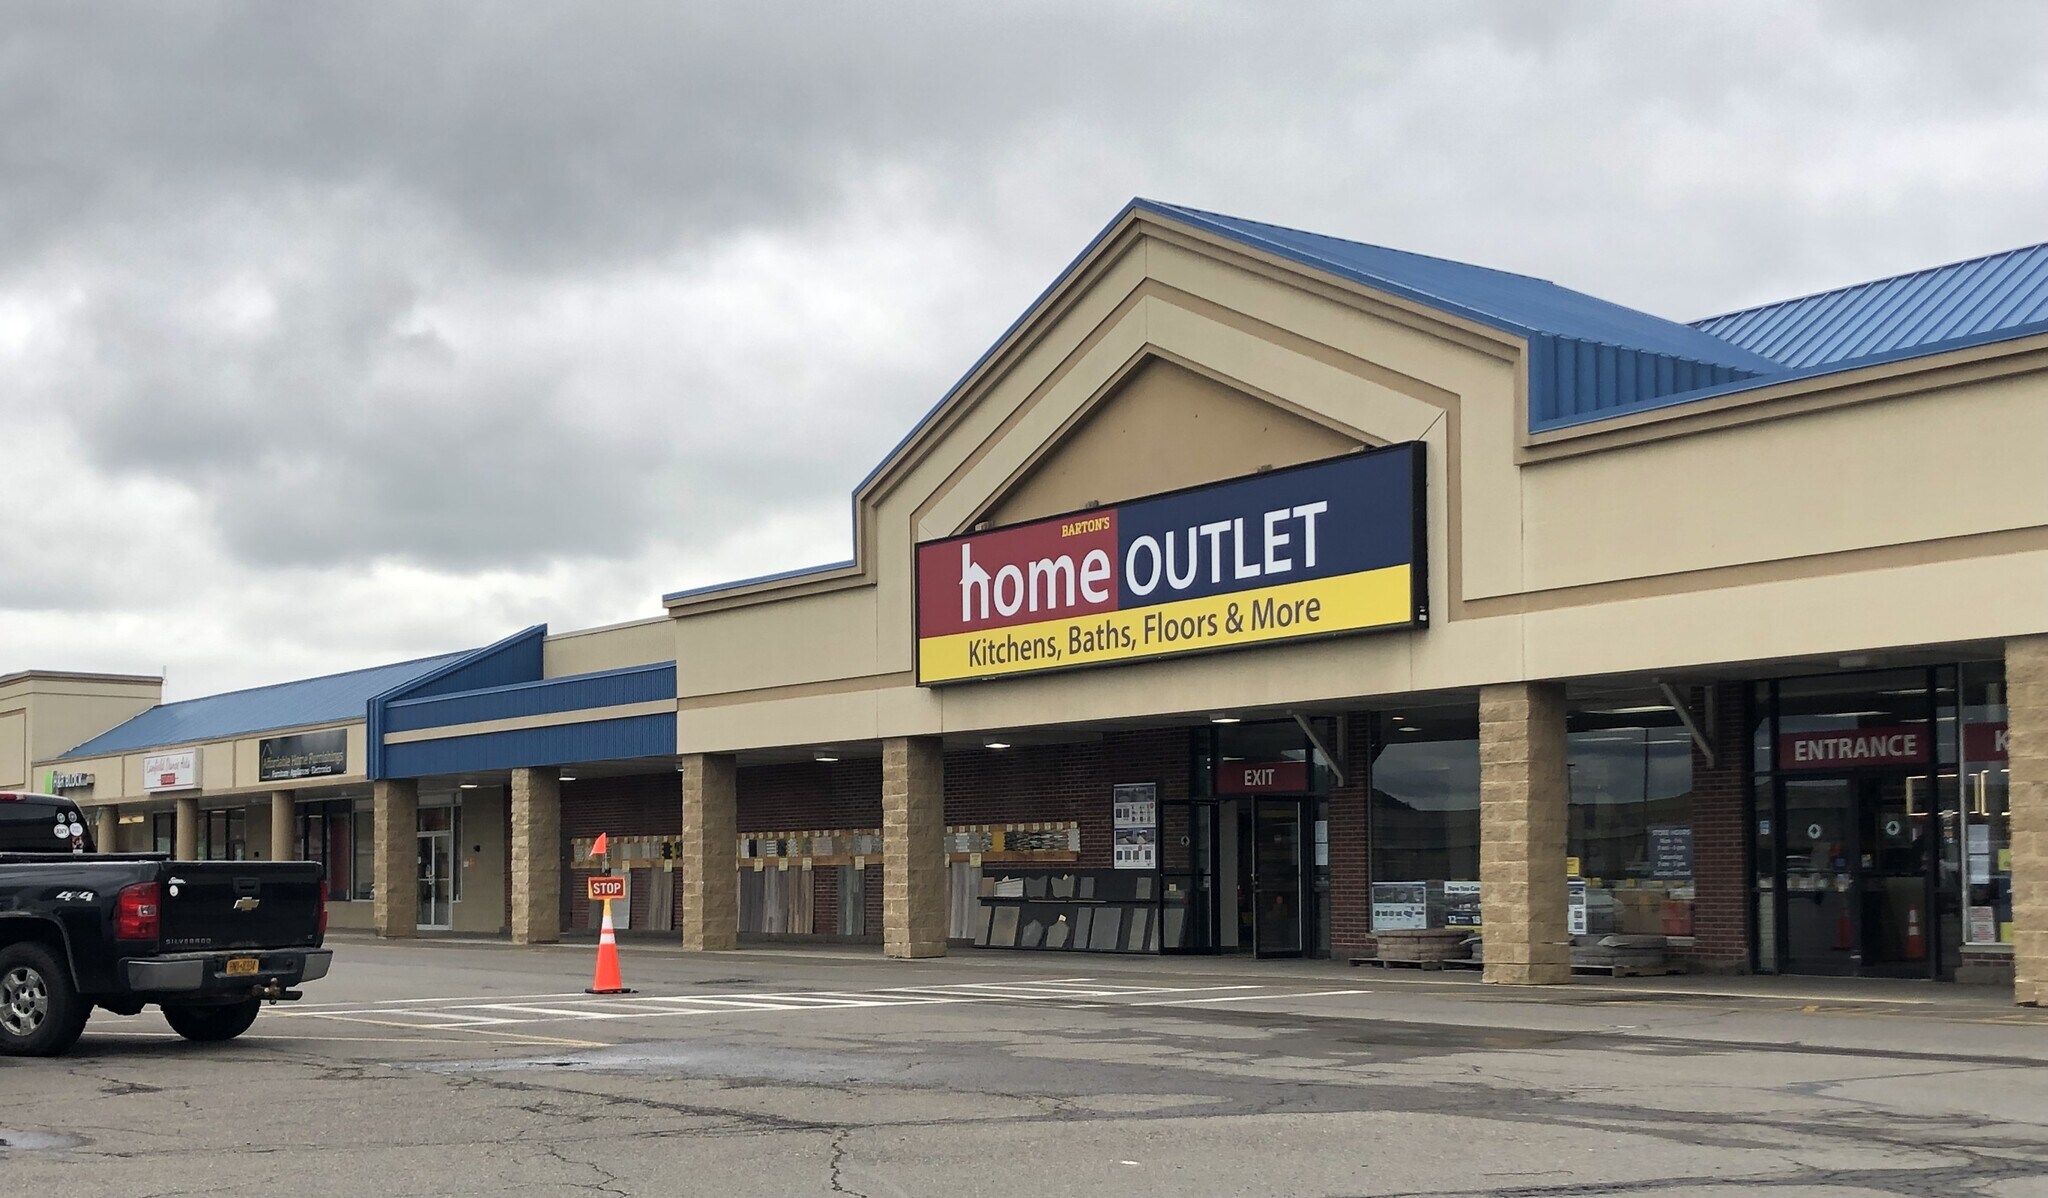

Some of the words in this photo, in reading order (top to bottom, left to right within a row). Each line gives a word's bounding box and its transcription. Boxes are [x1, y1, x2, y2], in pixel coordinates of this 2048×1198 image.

[1062, 517, 1110, 538] BARTON'S
[959, 543, 1111, 622] home
[1126, 501, 1328, 596] OUTLET
[969, 632, 1062, 668] Kitchens,
[1069, 620, 1137, 655] Baths,
[1145, 612, 1218, 645] Floors
[1226, 602, 1244, 634] &
[1252, 598, 1321, 631] More
[1794, 734, 1918, 761] ENTRANCE
[1244, 769, 1275, 786] EXIT
[593, 882, 621, 894] STOP
[165, 937, 212, 945] SILVERADO
